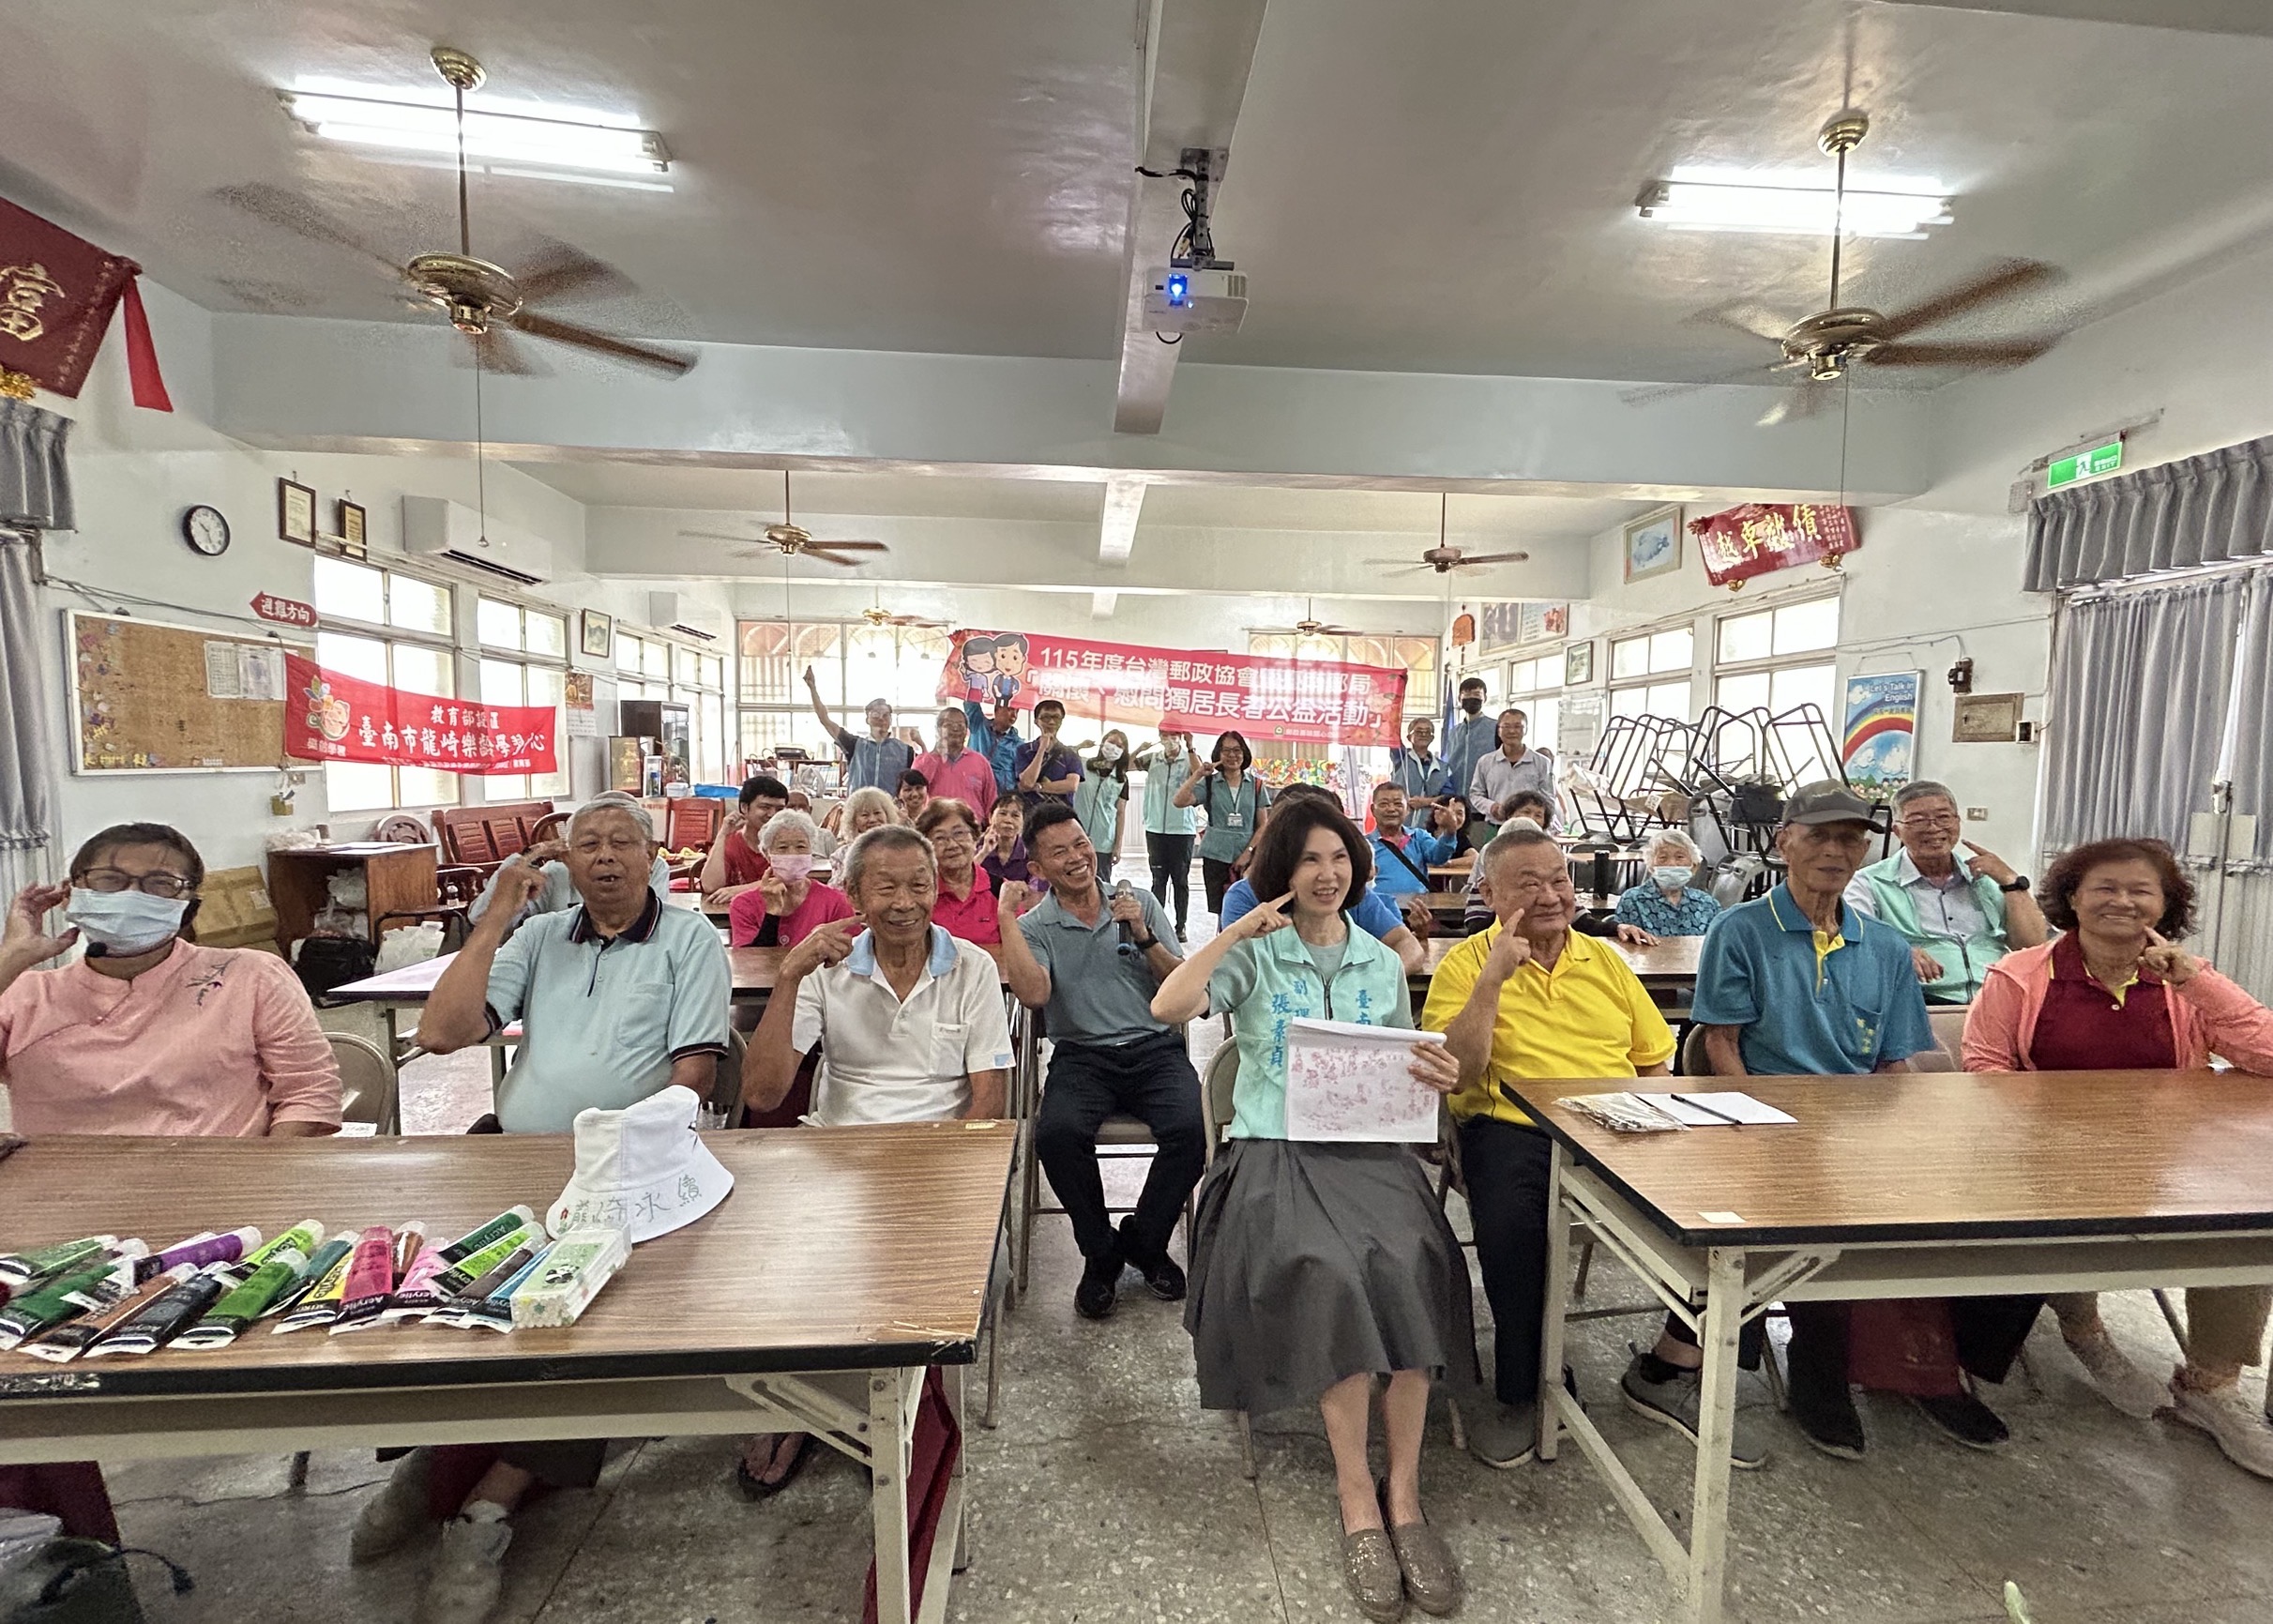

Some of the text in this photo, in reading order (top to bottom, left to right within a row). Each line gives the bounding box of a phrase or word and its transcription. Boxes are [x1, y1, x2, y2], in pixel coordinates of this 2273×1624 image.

[261, 597, 311, 623] 避難方向
[1039, 646, 1371, 696] 115年度台灣郵政協會局
[1885, 692, 1914, 704] English
[358, 715, 545, 758] 臺南市龍崎樂齡學習心
[1270, 993, 1293, 1069] 張素貞
[342, 1296, 384, 1311] Acrylic
